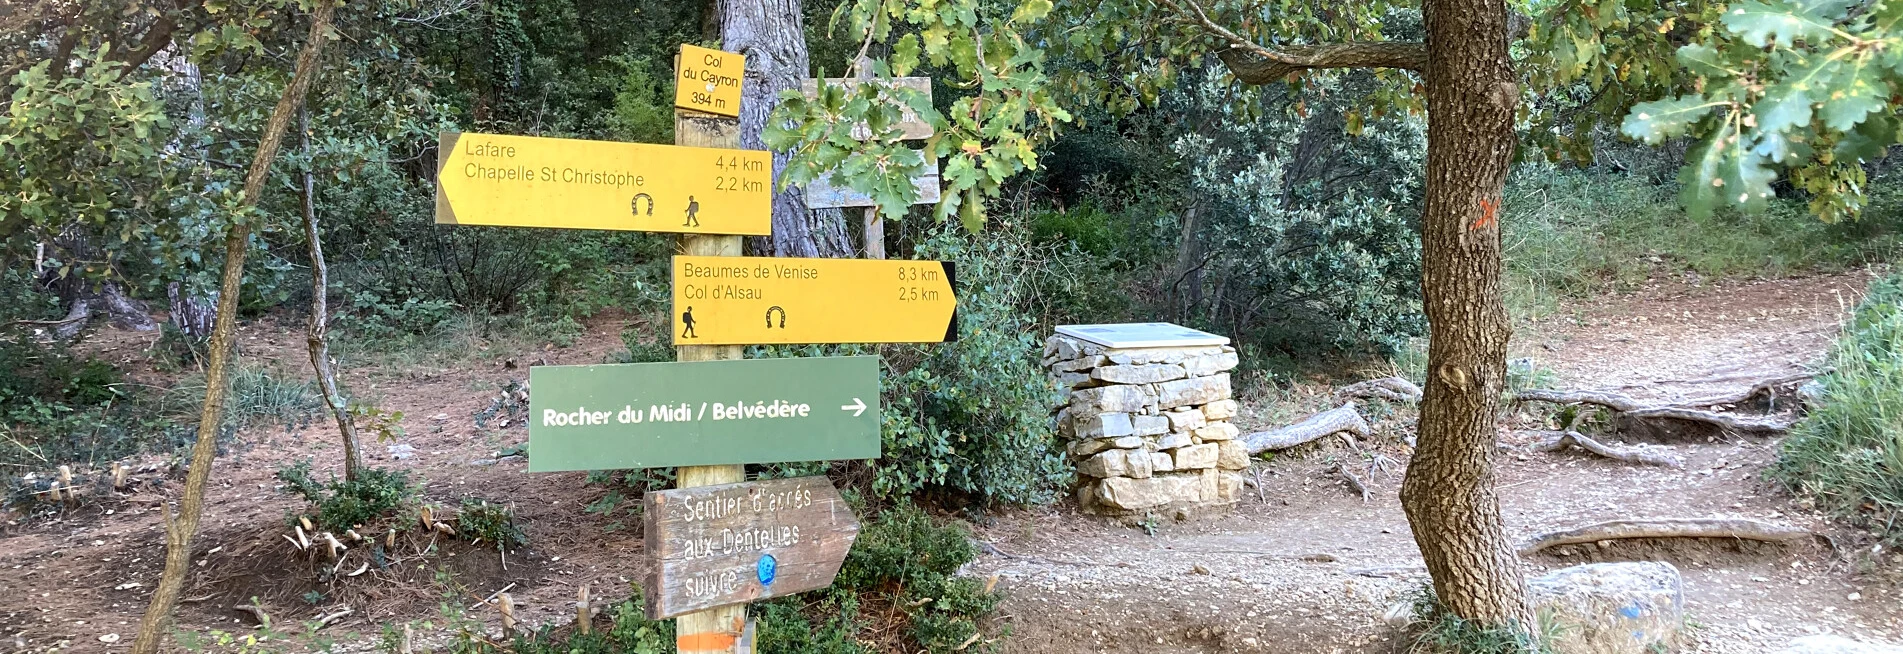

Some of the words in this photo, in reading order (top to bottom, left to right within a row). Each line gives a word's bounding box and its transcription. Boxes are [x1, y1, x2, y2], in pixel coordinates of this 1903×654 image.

[704, 54, 722, 68] Col
[683, 67, 697, 80] du
[700, 69, 738, 87] Cayron
[691, 91, 712, 106] 394
[715, 98, 726, 109] m
[465, 140, 516, 158] Lafare
[715, 155, 738, 172] 4,4
[743, 156, 763, 171] km
[464, 162, 535, 182] Chapelle
[541, 166, 557, 182] St
[562, 167, 645, 189] Christophe
[715, 176, 738, 193] 2,2
[743, 177, 763, 192] km
[684, 262, 749, 278] Beaumes
[753, 264, 770, 279] de
[774, 264, 818, 280] Venise
[898, 266, 917, 283] 8,3
[921, 267, 938, 281] km
[684, 284, 707, 299] Col
[712, 284, 762, 300] d'Alsau
[899, 286, 918, 303] 2,5
[921, 287, 939, 301] km
[543, 406, 612, 427] Rocher
[617, 405, 643, 424] du
[649, 403, 692, 422] Midi
[697, 402, 708, 421] /
[712, 399, 811, 421] Belvédère
[684, 491, 743, 522] Sentier
[684, 537, 714, 561] aux
[723, 525, 800, 555] Dentelles
[685, 569, 737, 598] suivre
